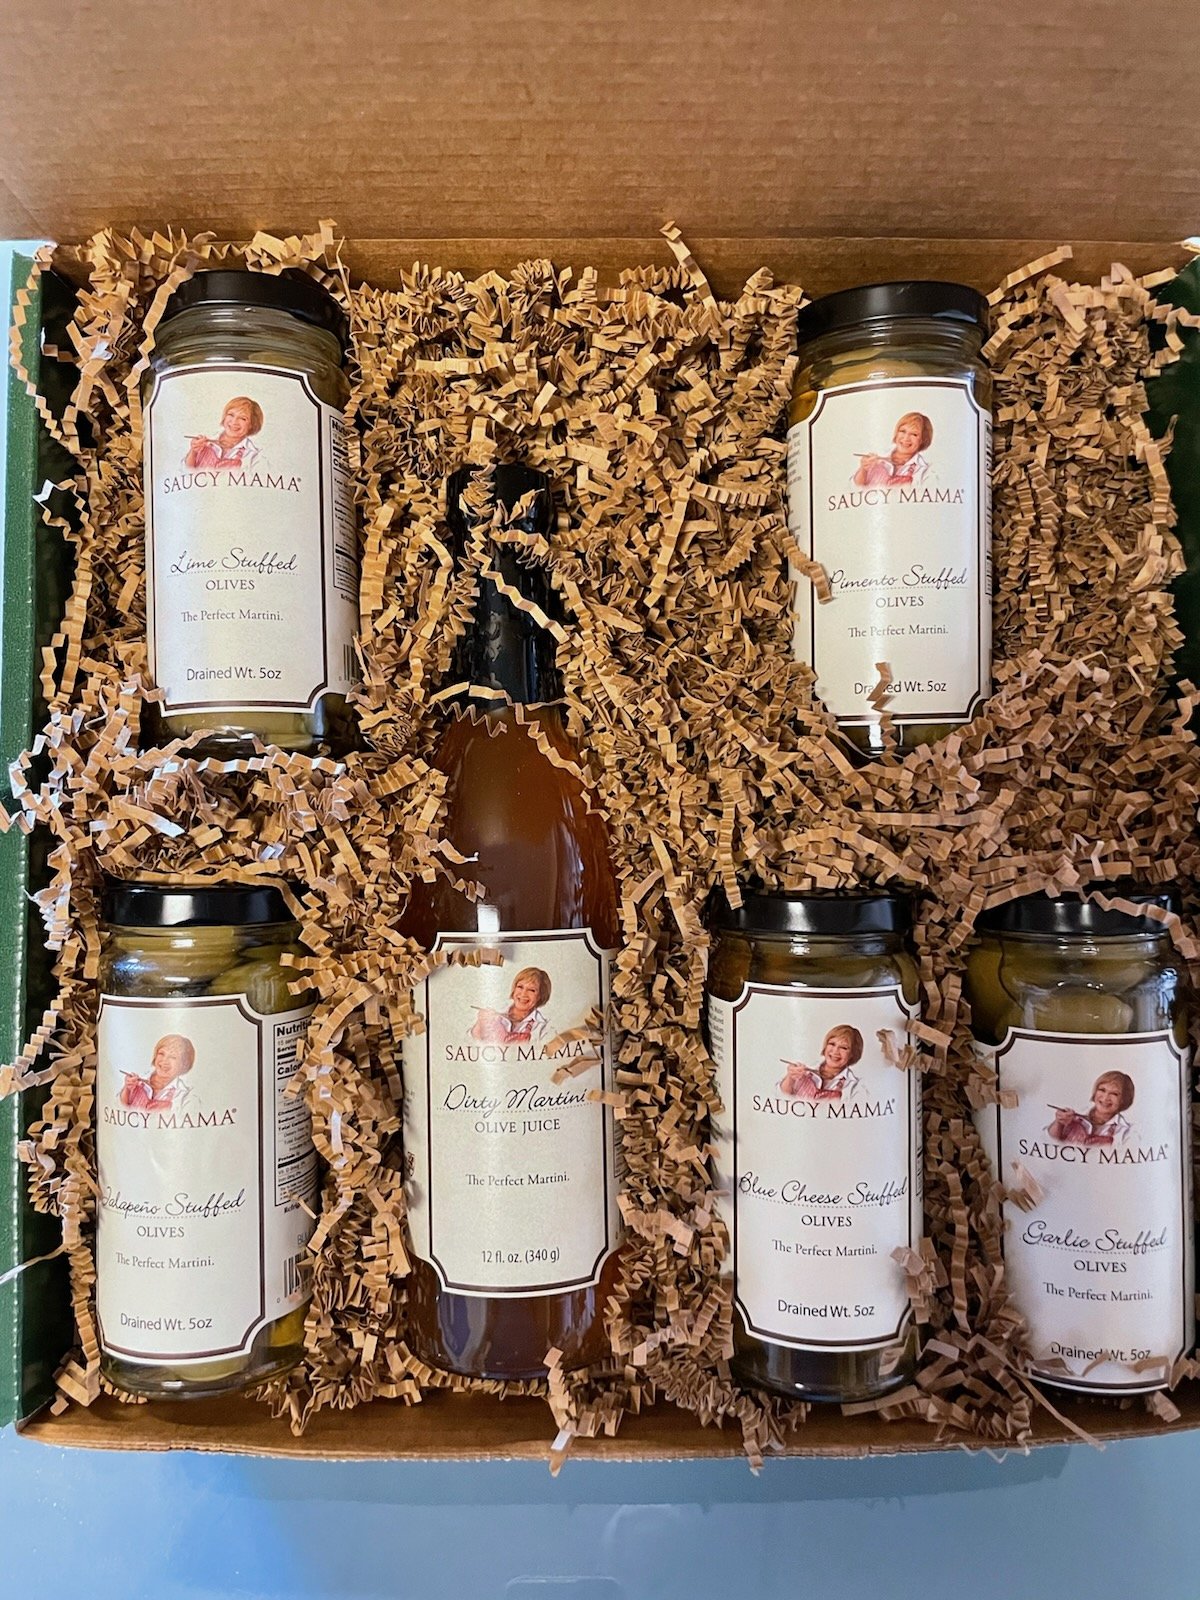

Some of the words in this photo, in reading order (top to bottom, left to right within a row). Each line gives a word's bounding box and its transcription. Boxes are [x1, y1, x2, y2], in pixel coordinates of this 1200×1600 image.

[164, 472, 219, 494] SAUCY
[828, 488, 892, 511] SAUCY
[170, 550, 217, 574] Lime
[221, 547, 297, 574] Stuffed
[205, 579, 255, 591] OLIVES
[829, 568, 898, 590] Pimento
[902, 564, 968, 590] Stuffed
[875, 596, 924, 608] OLIVES
[181, 611, 198, 622] The
[200, 610, 236, 621] Perfect
[239, 609, 284, 622] Martini.
[848, 627, 867, 638] The
[870, 624, 905, 637] Perfect
[908, 624, 949, 635] Martini.
[186, 667, 232, 681] Drained
[235, 668, 256, 679] Wt.
[259, 667, 282, 679] 5oz
[854, 681, 901, 695] Draed
[904, 681, 924, 693] Wt.
[927, 681, 947, 692] 5oz
[445, 1044, 508, 1061] SAUCY
[444, 1084, 500, 1118] Dirty
[505, 1085, 587, 1110] Martini
[753, 1095, 820, 1119] SAUCY
[104, 1106, 152, 1129] SAUCY
[475, 1121, 517, 1133] OLIVE
[522, 1118, 561, 1135] JUICE
[1019, 1139, 1090, 1164] SAUCY
[466, 1173, 485, 1186] The
[488, 1175, 524, 1186] Perfect
[527, 1171, 570, 1185] Martini.
[739, 1171, 778, 1198] Blue
[781, 1180, 842, 1204] Cheese
[847, 1176, 908, 1206] Stuffed
[165, 1188, 246, 1217] Stuffed
[801, 1215, 852, 1227] OLIVES
[136, 1226, 185, 1238] OLIVES
[1022, 1220, 1090, 1249] Garlic
[1095, 1227, 1168, 1255] Stuffed
[482, 1250, 493, 1263] 12
[507, 1253, 523, 1263] oz.
[525, 1249, 548, 1263] (340
[549, 1247, 560, 1263] g)
[772, 1239, 792, 1253] The
[795, 1243, 832, 1256] Perfect
[835, 1244, 878, 1257] Martini.
[116, 1253, 131, 1266] The
[132, 1255, 165, 1269] Perfect
[168, 1256, 215, 1269] Martini.
[1073, 1260, 1127, 1273] OLIVES
[1043, 1282, 1065, 1297] The
[1068, 1287, 1107, 1301] Perfect
[1110, 1289, 1153, 1301] Martini.
[777, 1300, 828, 1318] Drained
[830, 1305, 851, 1318] Wt.
[854, 1303, 875, 1317] 5oz
[120, 1313, 162, 1331] Drained
[165, 1317, 186, 1331] Wt.
[188, 1317, 213, 1329] 5oz
